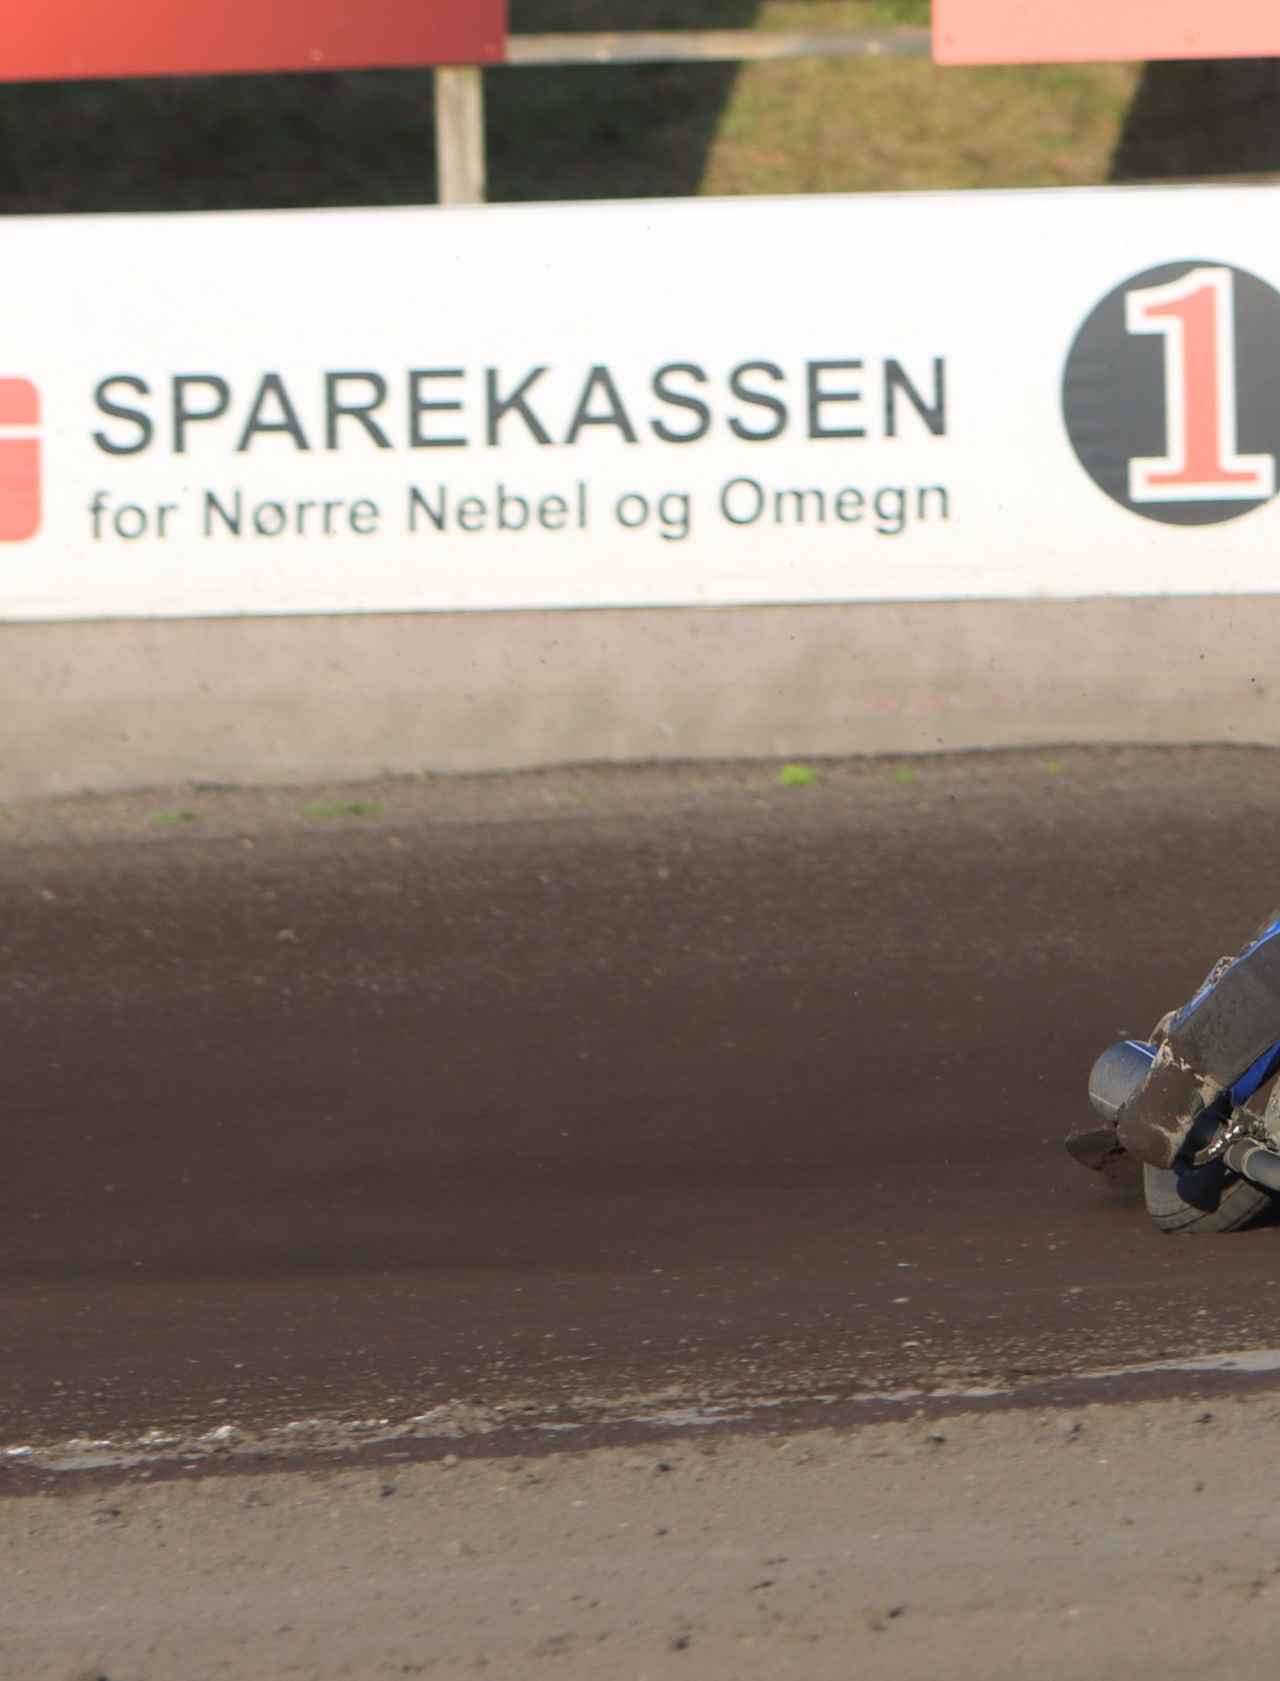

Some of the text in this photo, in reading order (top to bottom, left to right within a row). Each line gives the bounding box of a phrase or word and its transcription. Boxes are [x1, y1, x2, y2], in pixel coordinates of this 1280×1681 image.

[91, 358, 949, 457] SPAREKASSEN
[1126, 266, 1276, 502] 1
[90, 475, 951, 542] for Nørre Nebel og Omegn
